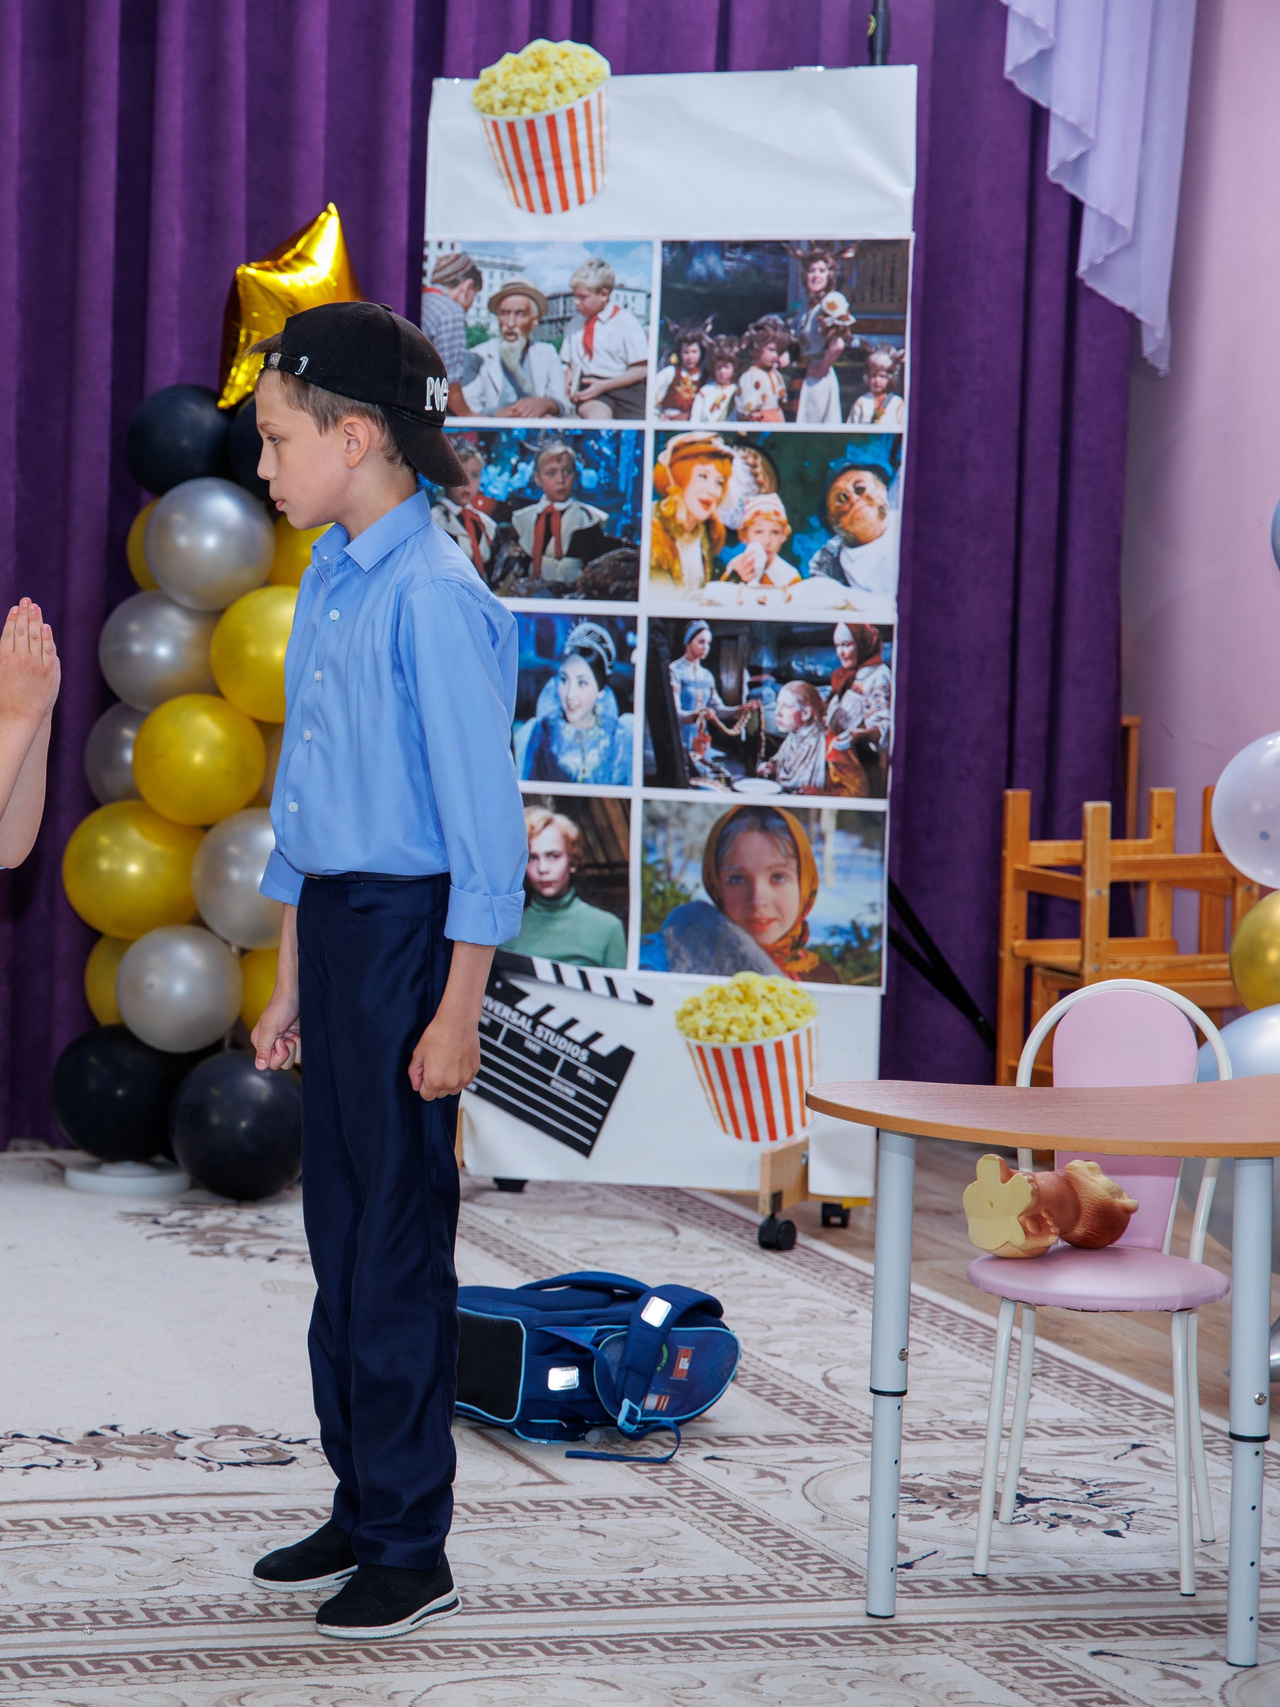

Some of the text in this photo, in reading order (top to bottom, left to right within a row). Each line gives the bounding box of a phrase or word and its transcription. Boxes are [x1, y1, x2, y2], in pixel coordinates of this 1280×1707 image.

[482, 996, 590, 1063] IVERSAL STUDIOS
[550, 1080, 577, 1098] SOUND
